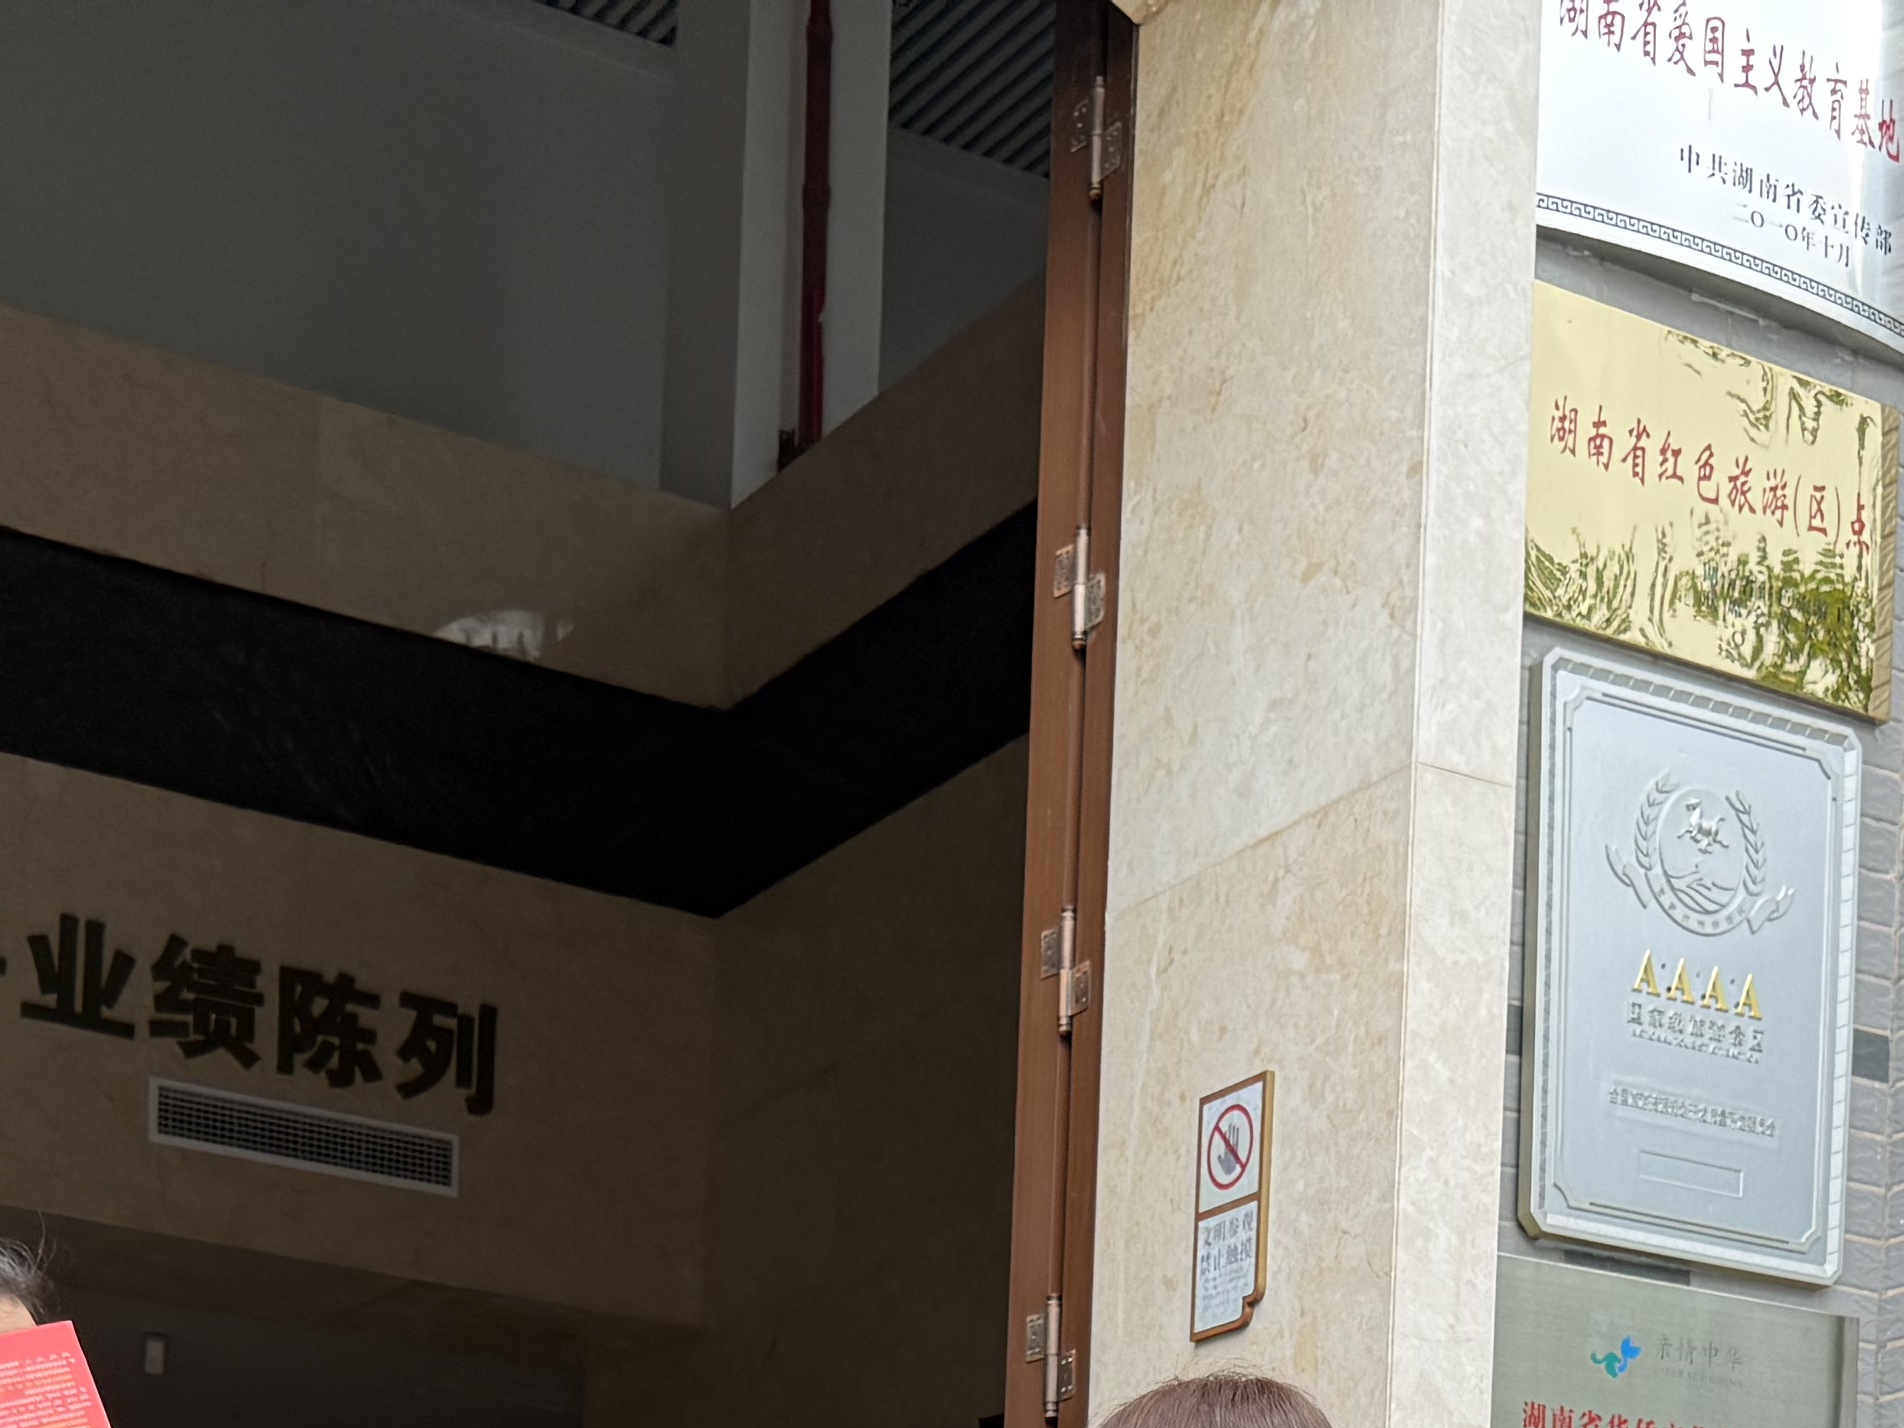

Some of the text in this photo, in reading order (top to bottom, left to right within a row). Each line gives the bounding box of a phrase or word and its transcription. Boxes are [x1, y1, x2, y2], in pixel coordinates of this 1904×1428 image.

[1679, 144, 1893, 257] 中共湖南省委宣传部
